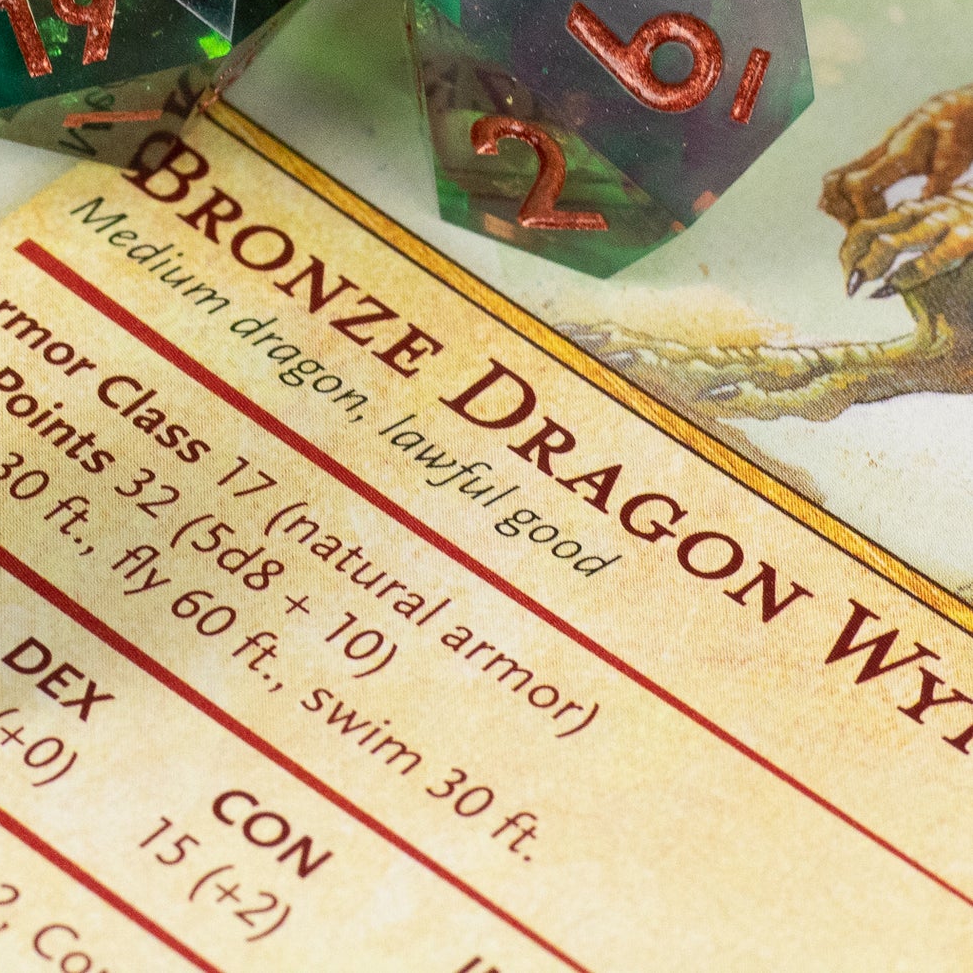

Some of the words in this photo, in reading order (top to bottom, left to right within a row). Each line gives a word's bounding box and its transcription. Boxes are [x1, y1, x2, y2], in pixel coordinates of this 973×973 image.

[470, 115, 608, 230] 2
[70, 195, 231, 315] Medium
[229, 317, 369, 424] dragon,
[377, 412, 520, 508] lawful
[493, 508, 623, 578] good
[439, 358, 815, 624] DRAGON
[97, 374, 212, 464] Class
[216, 455, 278, 499] 17
[263, 500, 452, 628] (natural
[440, 625, 601, 740] armor)
[113, 467, 181, 519] 32
[169, 513, 286, 592] (5d8
[285, 594, 310, 615] +
[324, 610, 398, 680] 10)
[0, 635, 115, 723] DEX
[43, 494, 95, 557] ft.,
[110, 544, 171, 597] fly
[170, 589, 238, 638] 60
[231, 630, 284, 694] ft.,
[300, 687, 423, 776] swim
[424, 767, 496, 819] 30
[490, 810, 539, 863] ft.
[138, 815, 201, 867] 15
[187, 864, 292, 944] (+2)
[211, 789, 334, 880] CON
